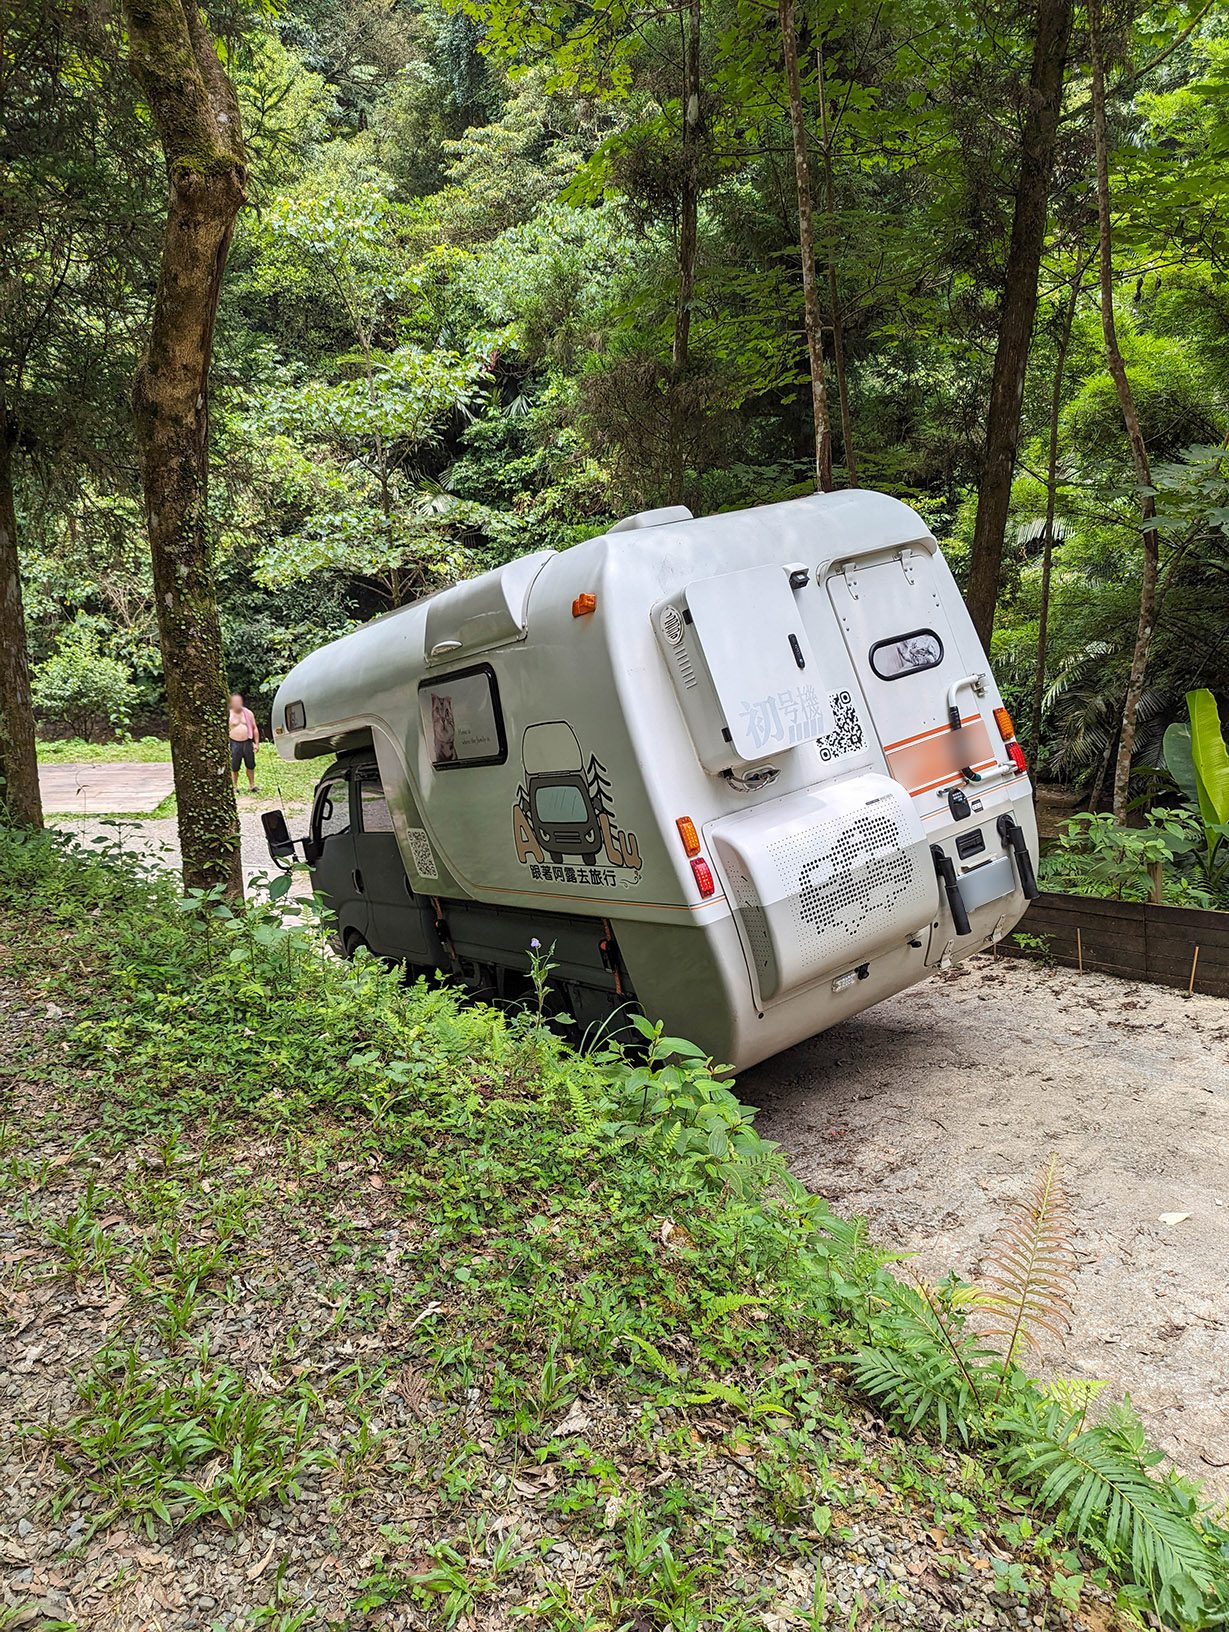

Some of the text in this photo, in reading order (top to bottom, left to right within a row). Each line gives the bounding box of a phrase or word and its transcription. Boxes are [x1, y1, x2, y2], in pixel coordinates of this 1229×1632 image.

[530, 864, 617, 887] 跟著阿露去旅行
